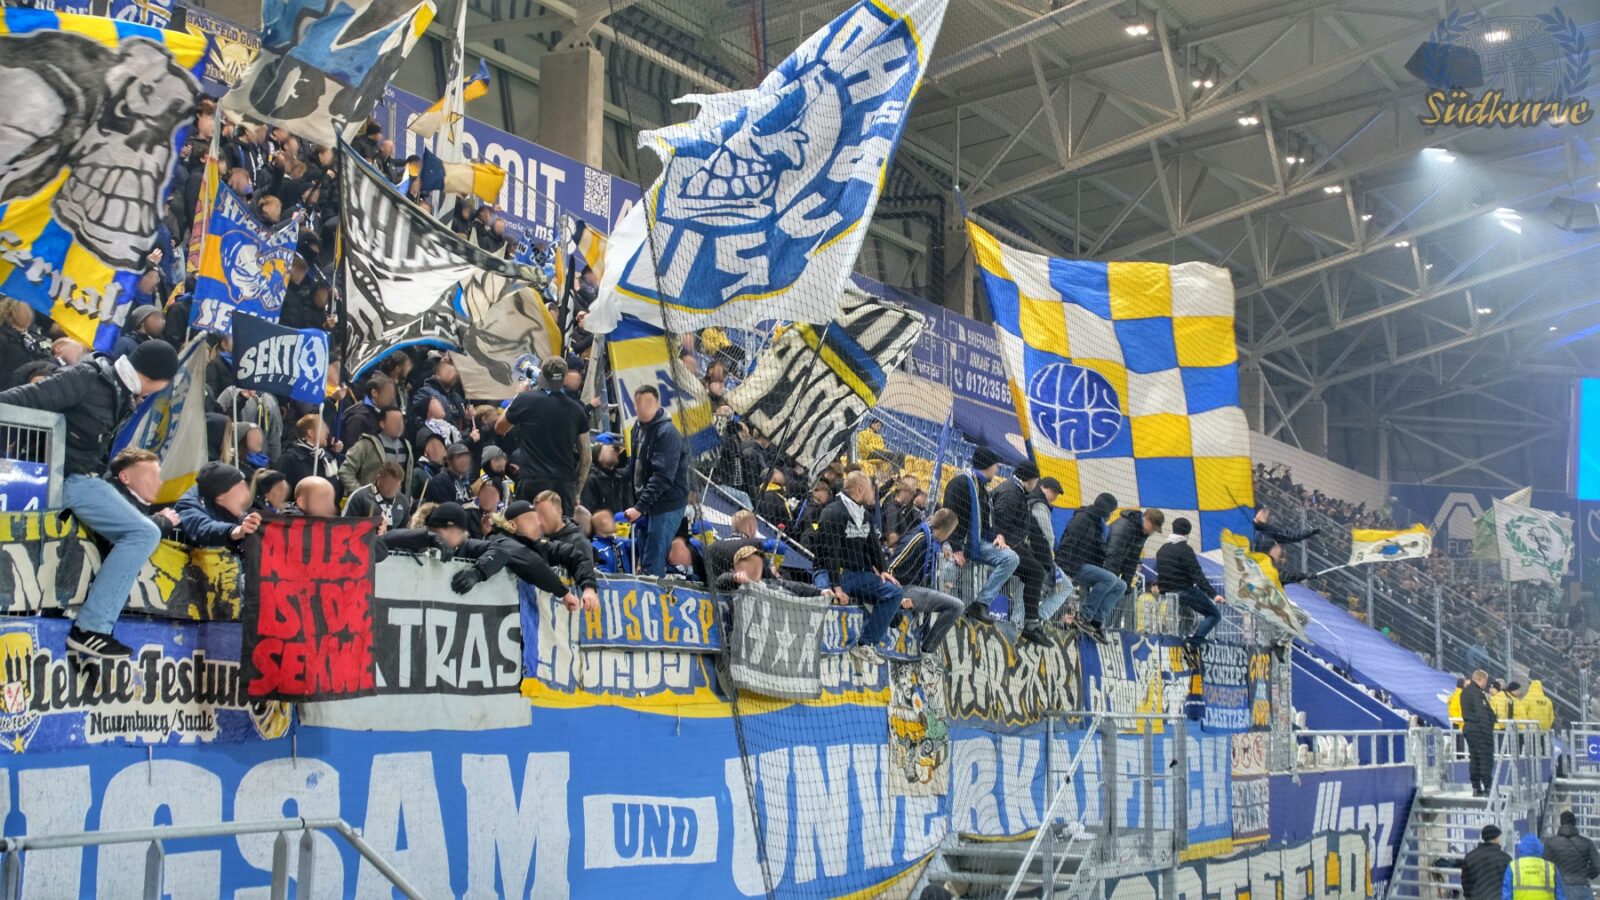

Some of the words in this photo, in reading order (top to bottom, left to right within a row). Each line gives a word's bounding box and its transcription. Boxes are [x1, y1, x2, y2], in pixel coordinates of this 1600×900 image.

[187, 11, 238, 42] SAALFELD
[254, 374, 320, 396] WEIMAR
[260, 519, 373, 581] ALLES
[585, 590, 715, 645] AUSGESP
[376, 607, 522, 689] TRAS
[1203, 662, 1248, 686] KONZEPT
[30, 652, 134, 711] Letzte
[139, 650, 254, 710] Festun
[90, 709, 215, 736] Naumburg/Saale
[612, 802, 699, 859] UND
